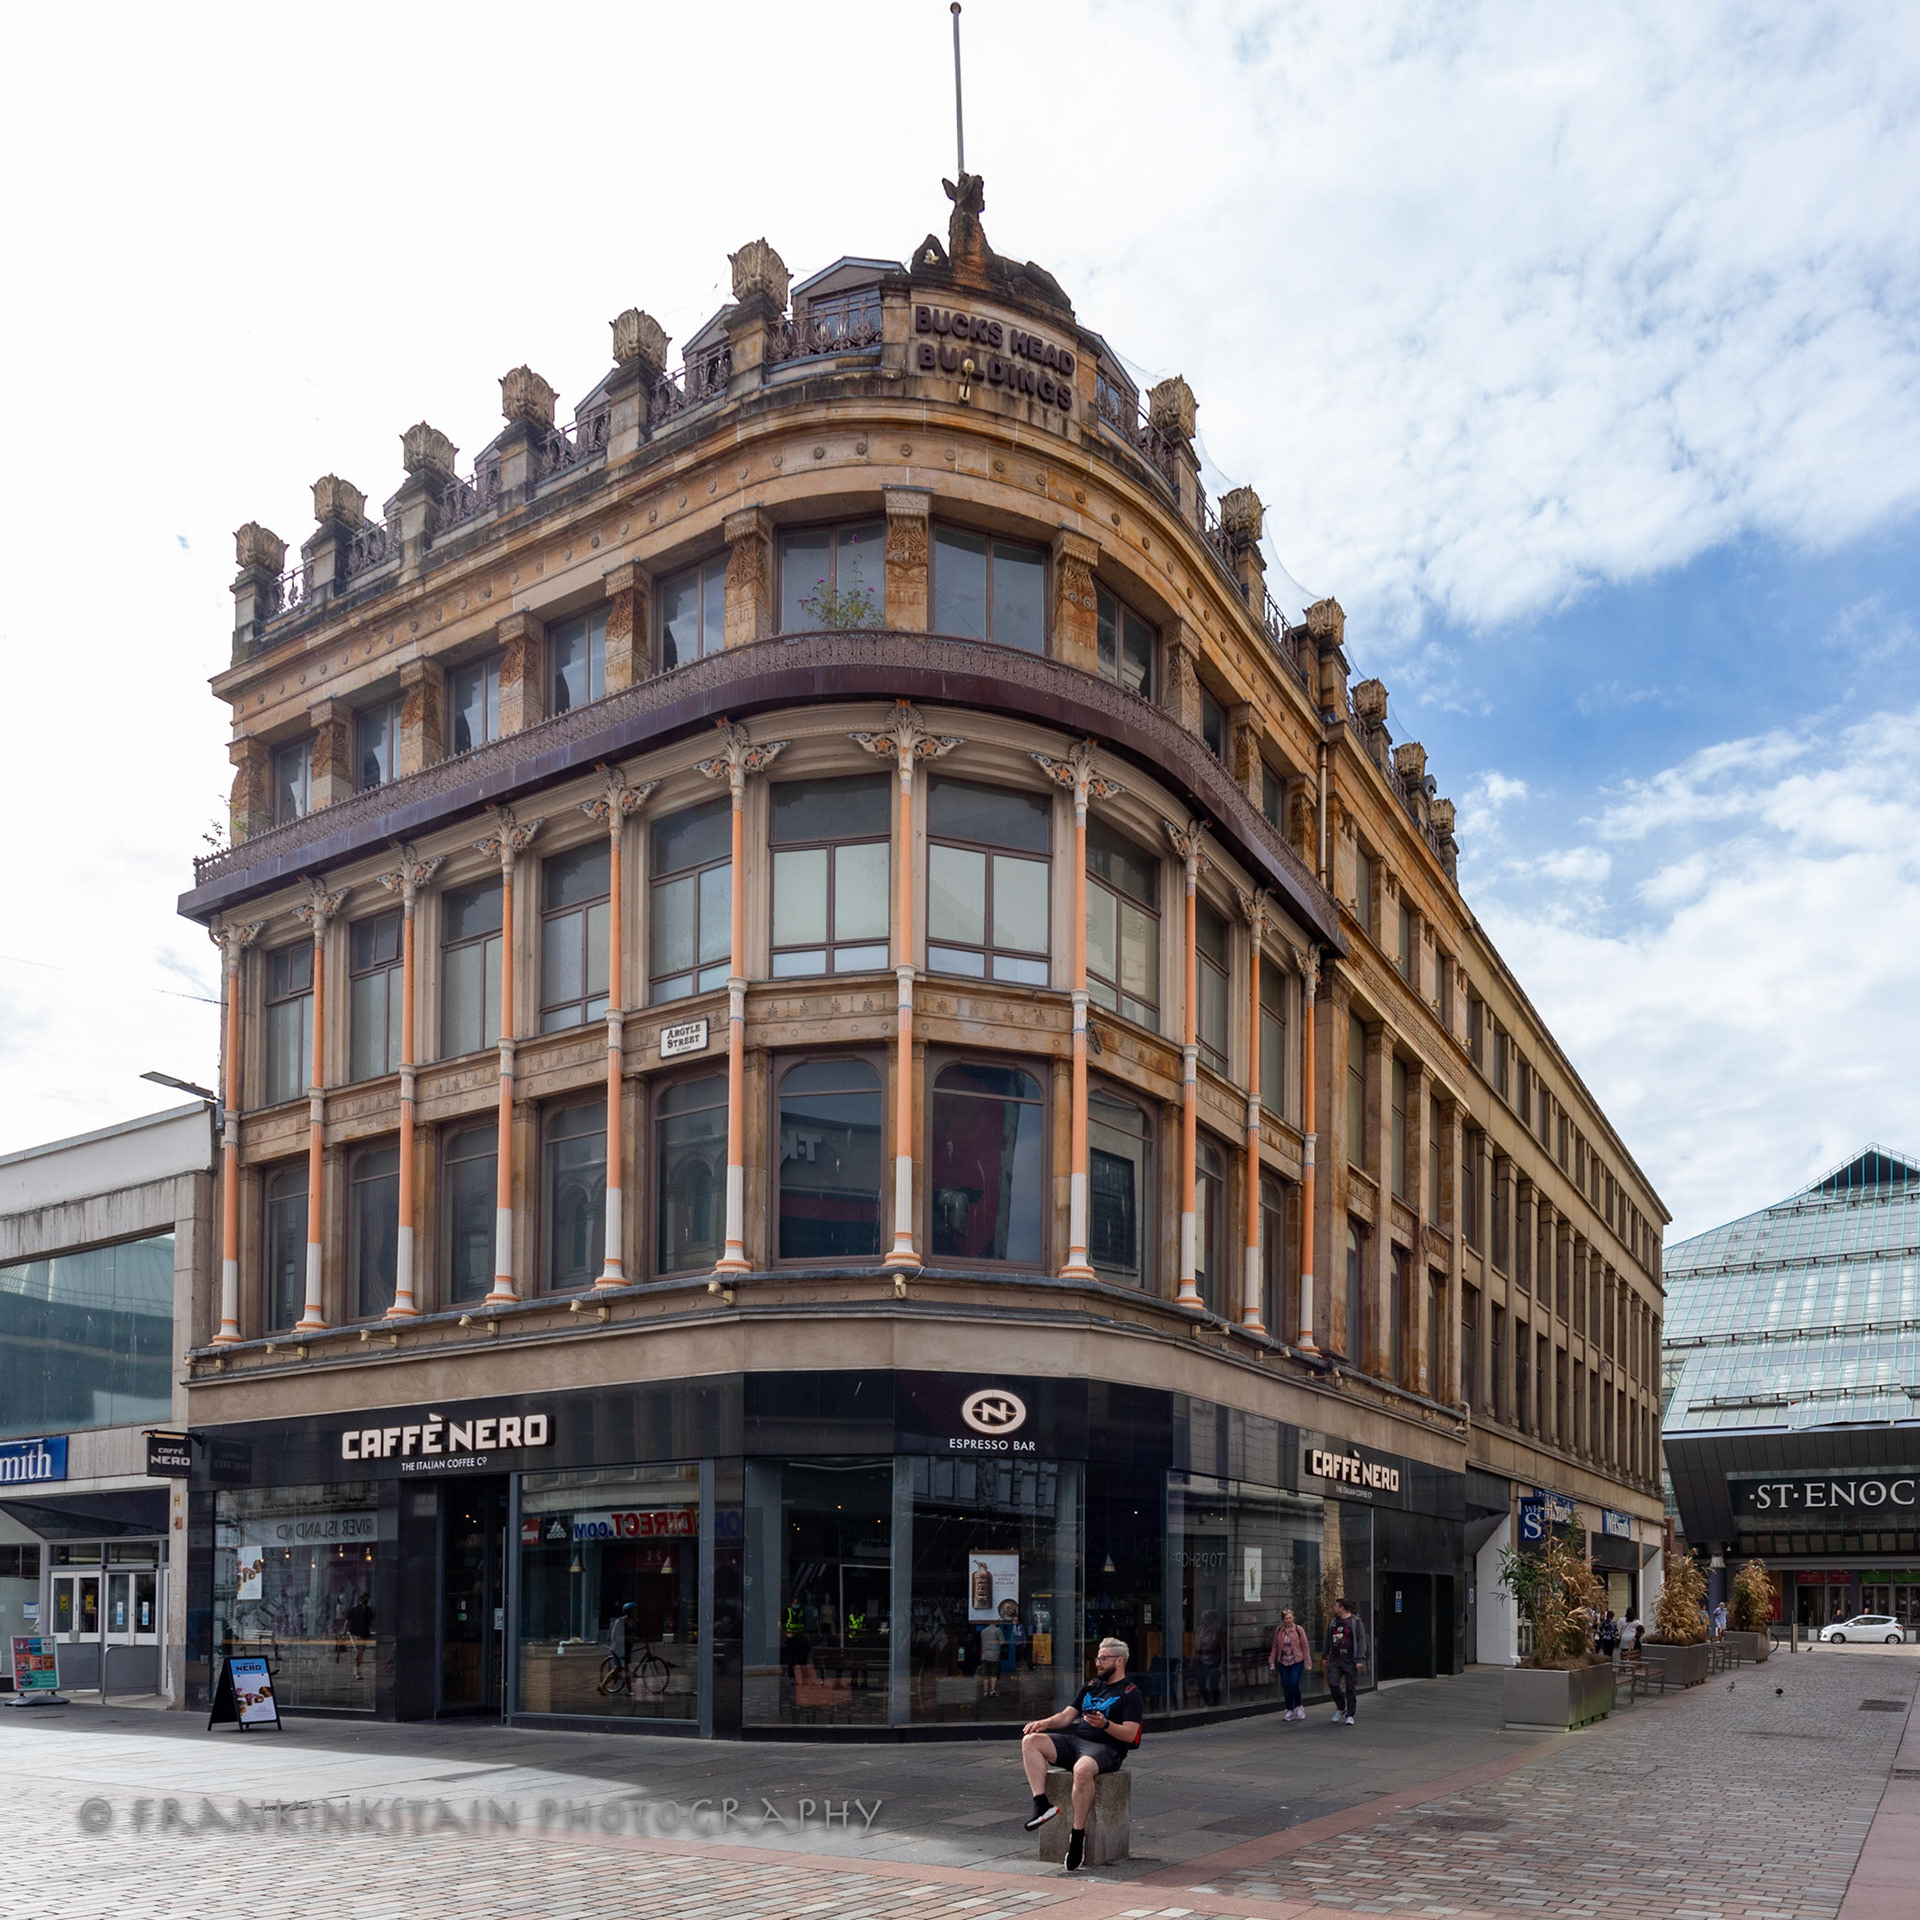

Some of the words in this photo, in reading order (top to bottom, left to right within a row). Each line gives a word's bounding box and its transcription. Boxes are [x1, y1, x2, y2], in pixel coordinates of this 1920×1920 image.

[915, 305, 1003, 348] BUCKS
[1011, 329, 1075, 376] HEAD
[918, 343, 1073, 411] BUILDINGS
[667, 1024, 701, 1039] ARGYLE
[667, 1035, 700, 1049] STREET
[341, 1412, 444, 1460] CAFFÈ
[449, 1414, 548, 1452] NERO
[949, 1438, 1009, 1451] ESPRESSO
[1013, 1440, 1036, 1451] BAR
[150, 1455, 191, 1466] NERO
[402, 1462, 415, 1472] THE
[416, 1460, 446, 1471] ITALIAN
[447, 1458, 475, 1469] COFFEE
[1312, 1449, 1361, 1484] CAFFÈ
[1362, 1461, 1399, 1492] NERO
[1343, 1487, 1356, 1496] ITALIAN
[1356, 1489, 1368, 1498] COFFEE
[1803, 1479, 1920, 1508] ENOC
